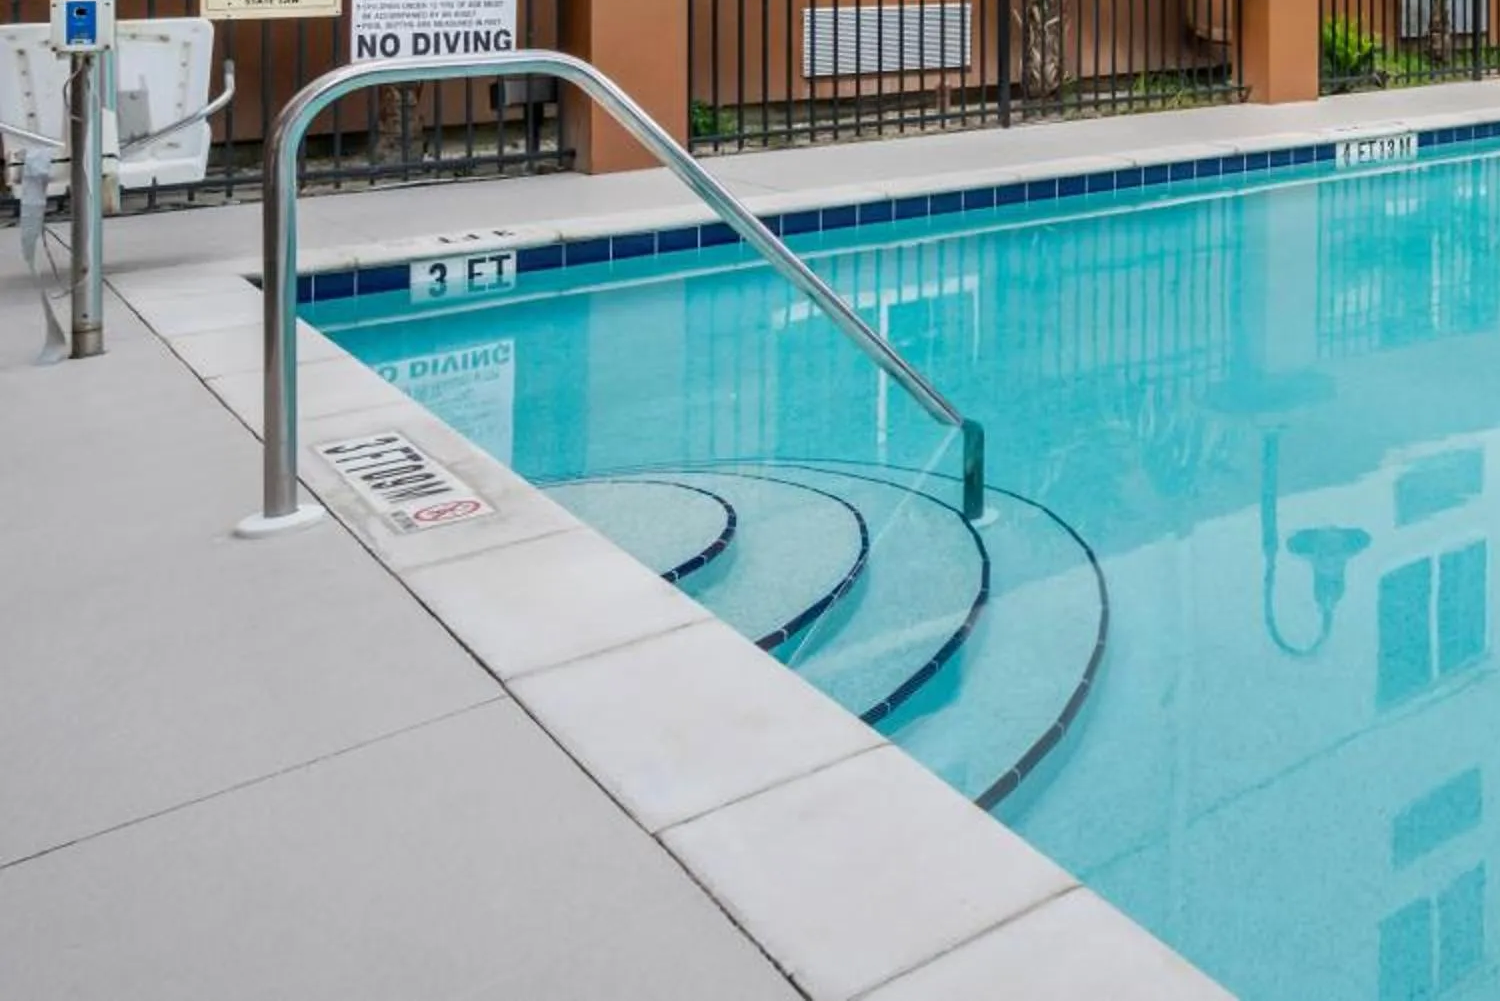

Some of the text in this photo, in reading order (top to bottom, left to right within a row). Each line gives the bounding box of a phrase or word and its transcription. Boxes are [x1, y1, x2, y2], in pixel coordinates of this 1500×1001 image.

[357, 29, 513, 59] NO DIVING
[429, 263, 448, 297] 3
